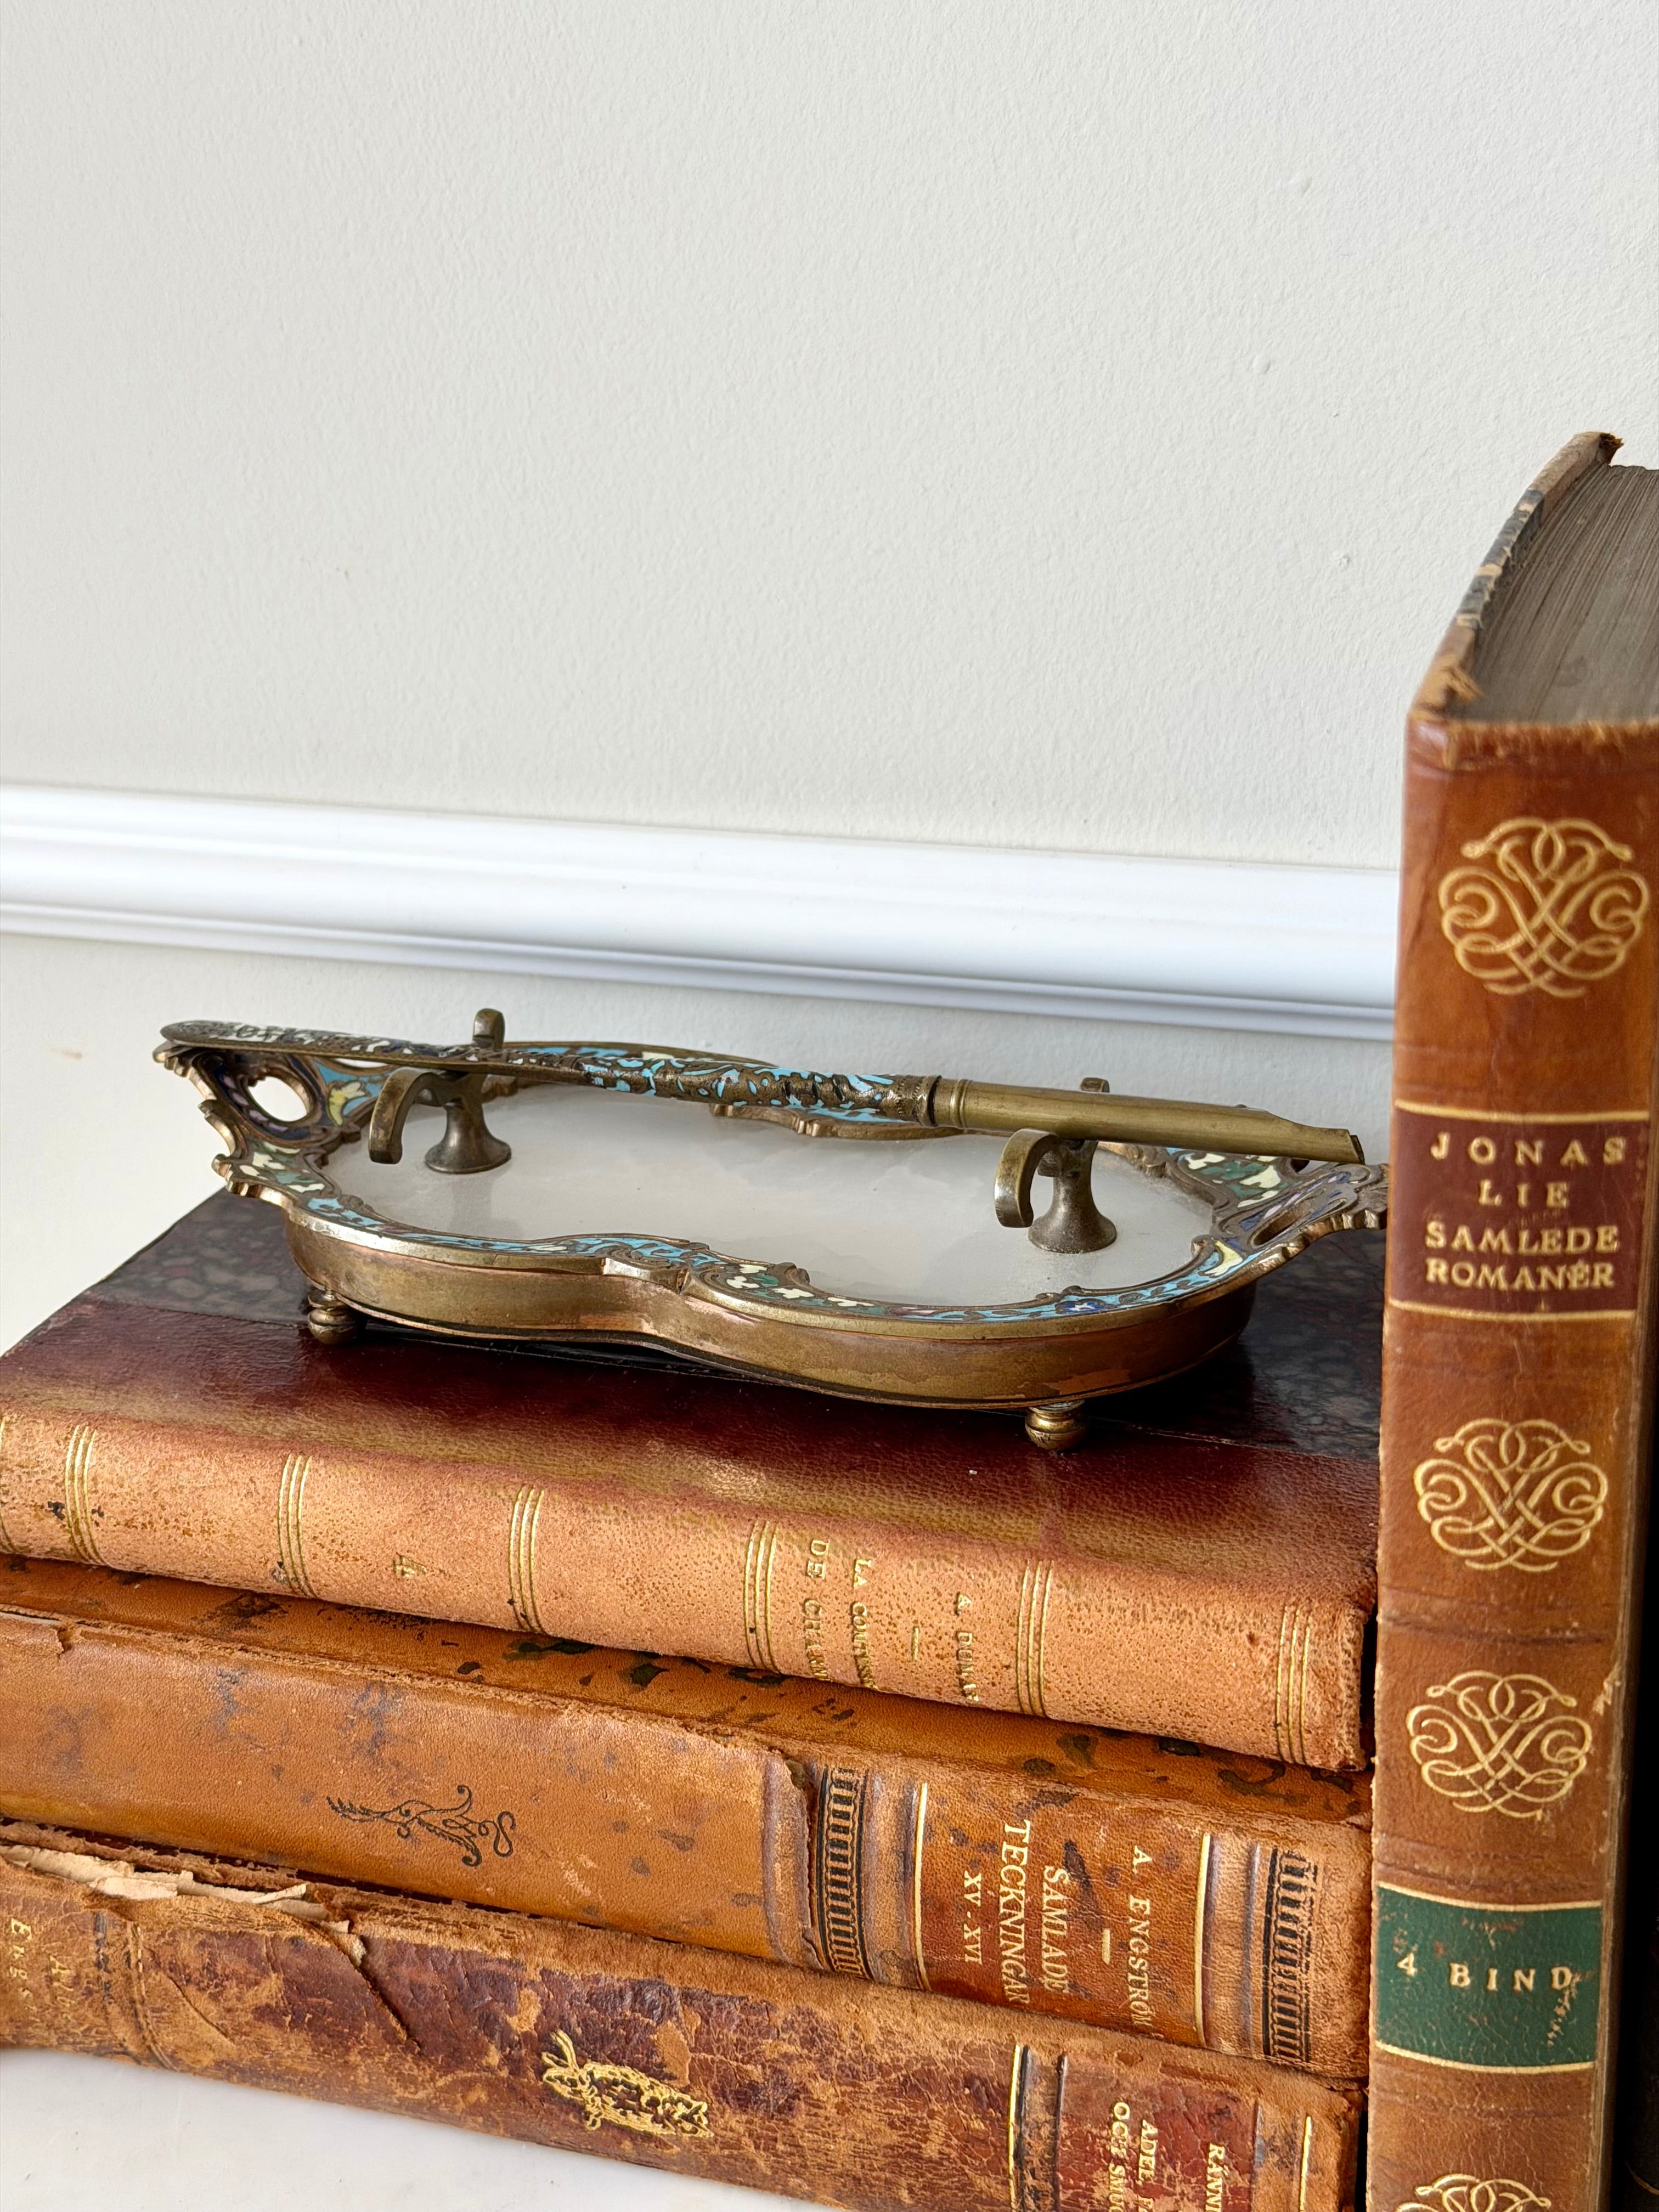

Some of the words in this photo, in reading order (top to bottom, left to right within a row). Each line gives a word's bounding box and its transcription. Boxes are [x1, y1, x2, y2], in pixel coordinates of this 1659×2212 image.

[1430, 1132, 1627, 1166] JONAS
[1479, 1180, 1570, 1207] LIE
[1426, 1221, 1619, 1255] SAMLEDE
[808, 1539, 829, 1579] DE
[854, 1558, 872, 1589] LA
[1132, 1845, 1153, 1875] A.
[964, 1871, 982, 1907] XV
[998, 1819, 1031, 2004] TECKNINGAR
[1041, 1865, 1070, 1994] SAMLADE
[963, 1923, 983, 1965] XVI
[1397, 1953, 1417, 1976] 4
[1451, 1963, 1572, 1991] BIND
[1137, 2119, 1158, 2186] ADEL,
[1206, 2143, 1228, 2212] RÄNNI
